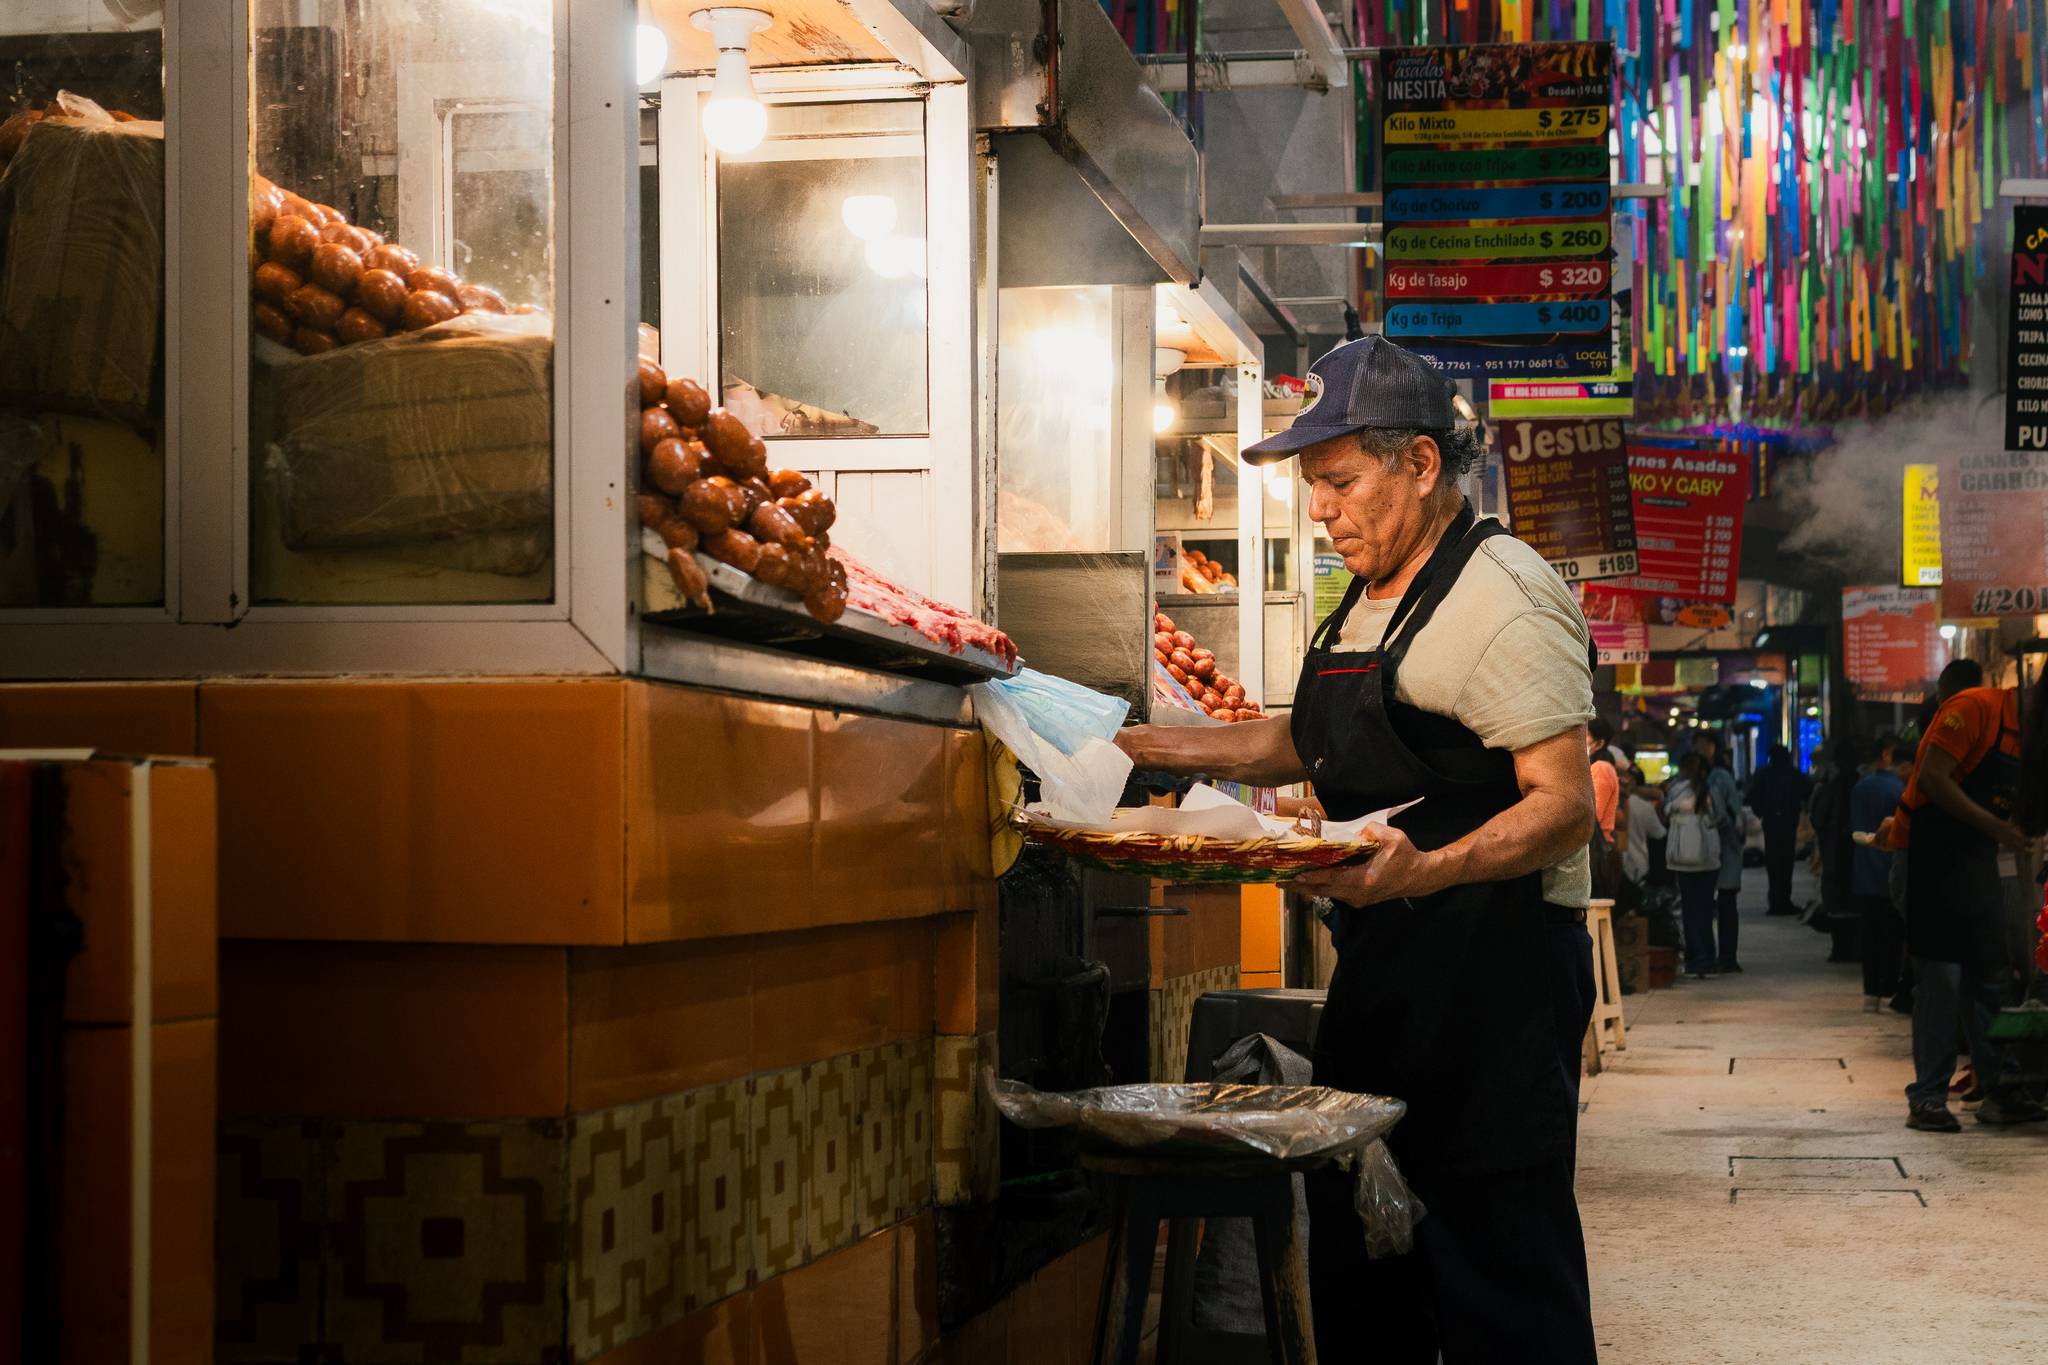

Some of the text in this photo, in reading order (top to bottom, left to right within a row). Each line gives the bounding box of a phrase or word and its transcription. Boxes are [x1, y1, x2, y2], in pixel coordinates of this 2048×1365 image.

[1387, 79, 1447, 100] INESITA
[1548, 85, 1576, 96] Desde
[1390, 109, 1600, 130] Kilo Mixto $ 275
[1540, 152, 1552, 170] $
[1560, 152, 1600, 168] 295
[1391, 191, 1601, 214] Kg de Chorizo $ 200
[1391, 230, 1601, 250] Kg de Cecina Enchilada $ 260
[1389, 267, 1602, 291] Kg de Tasajo $ 320
[1391, 305, 1600, 328] Kg de Tripa $ 400
[2018, 307, 2043, 321] LOMO
[2017, 330, 2045, 344] TRIPA
[1446, 361, 1471, 370] 7761
[1486, 360, 1504, 369] 951
[1507, 360, 1526, 369] 171
[1528, 359, 1553, 368] 0681
[1575, 351, 1608, 361] LOCAL
[1589, 360, 1608, 369] 191
[1672, 456, 1738, 475] Asadas
[1660, 476, 1672, 493] Y
[1676, 478, 1724, 496] GABY
[1599, 553, 1635, 574] #189
